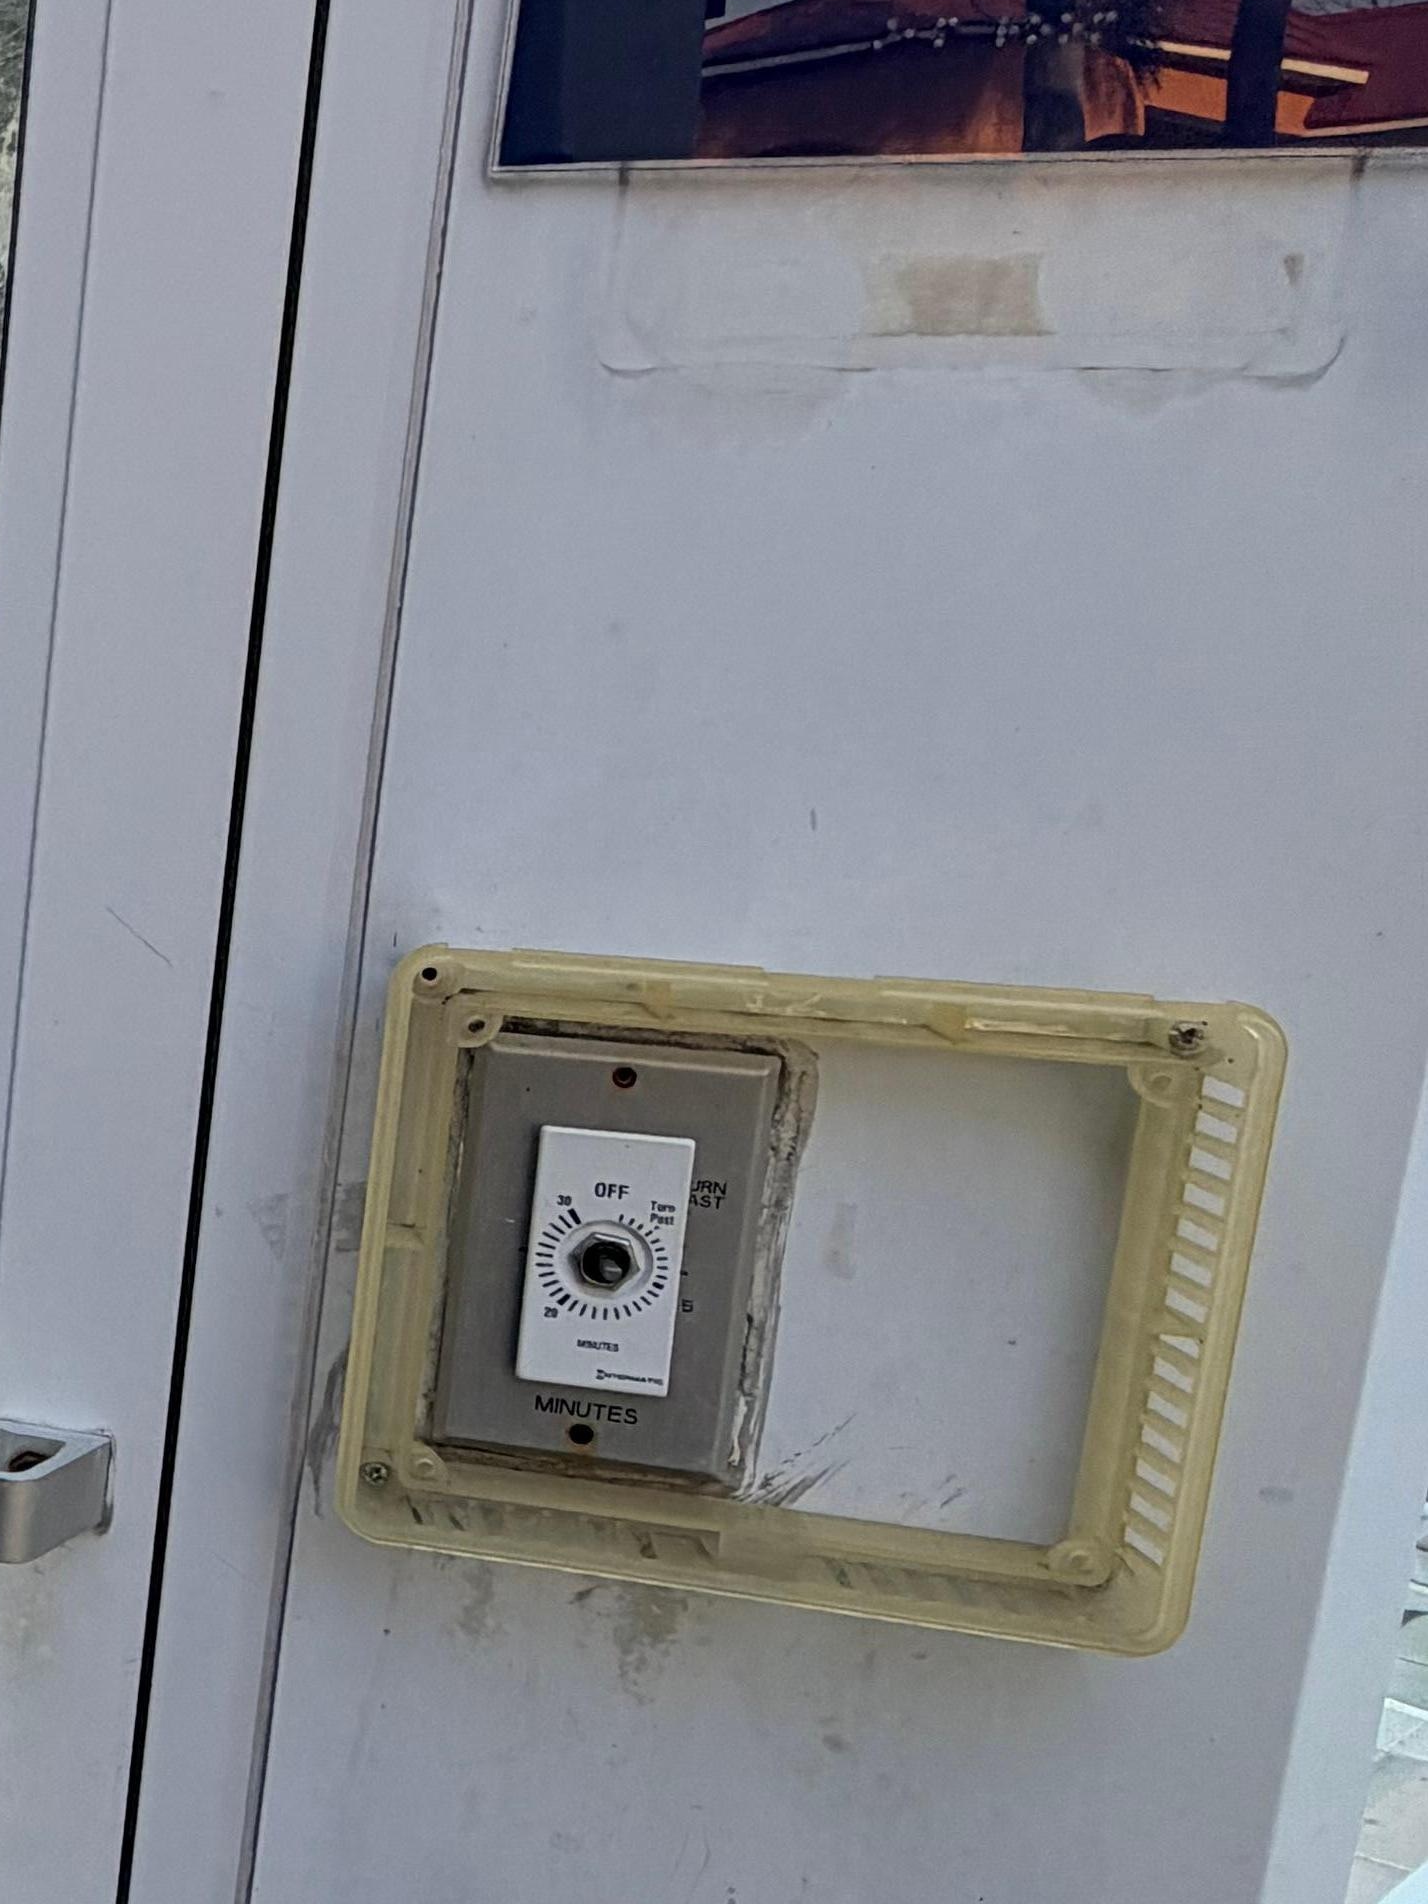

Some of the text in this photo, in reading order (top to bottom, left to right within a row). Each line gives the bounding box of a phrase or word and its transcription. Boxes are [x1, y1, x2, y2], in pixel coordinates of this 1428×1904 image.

[594, 1182, 630, 1200] OFF
[690, 1179, 727, 1196] URN
[557, 1194, 572, 1207] 30
[689, 1194, 727, 1210] AST
[543, 1306, 559, 1318] 20
[534, 1394, 638, 1425] MINUTES
